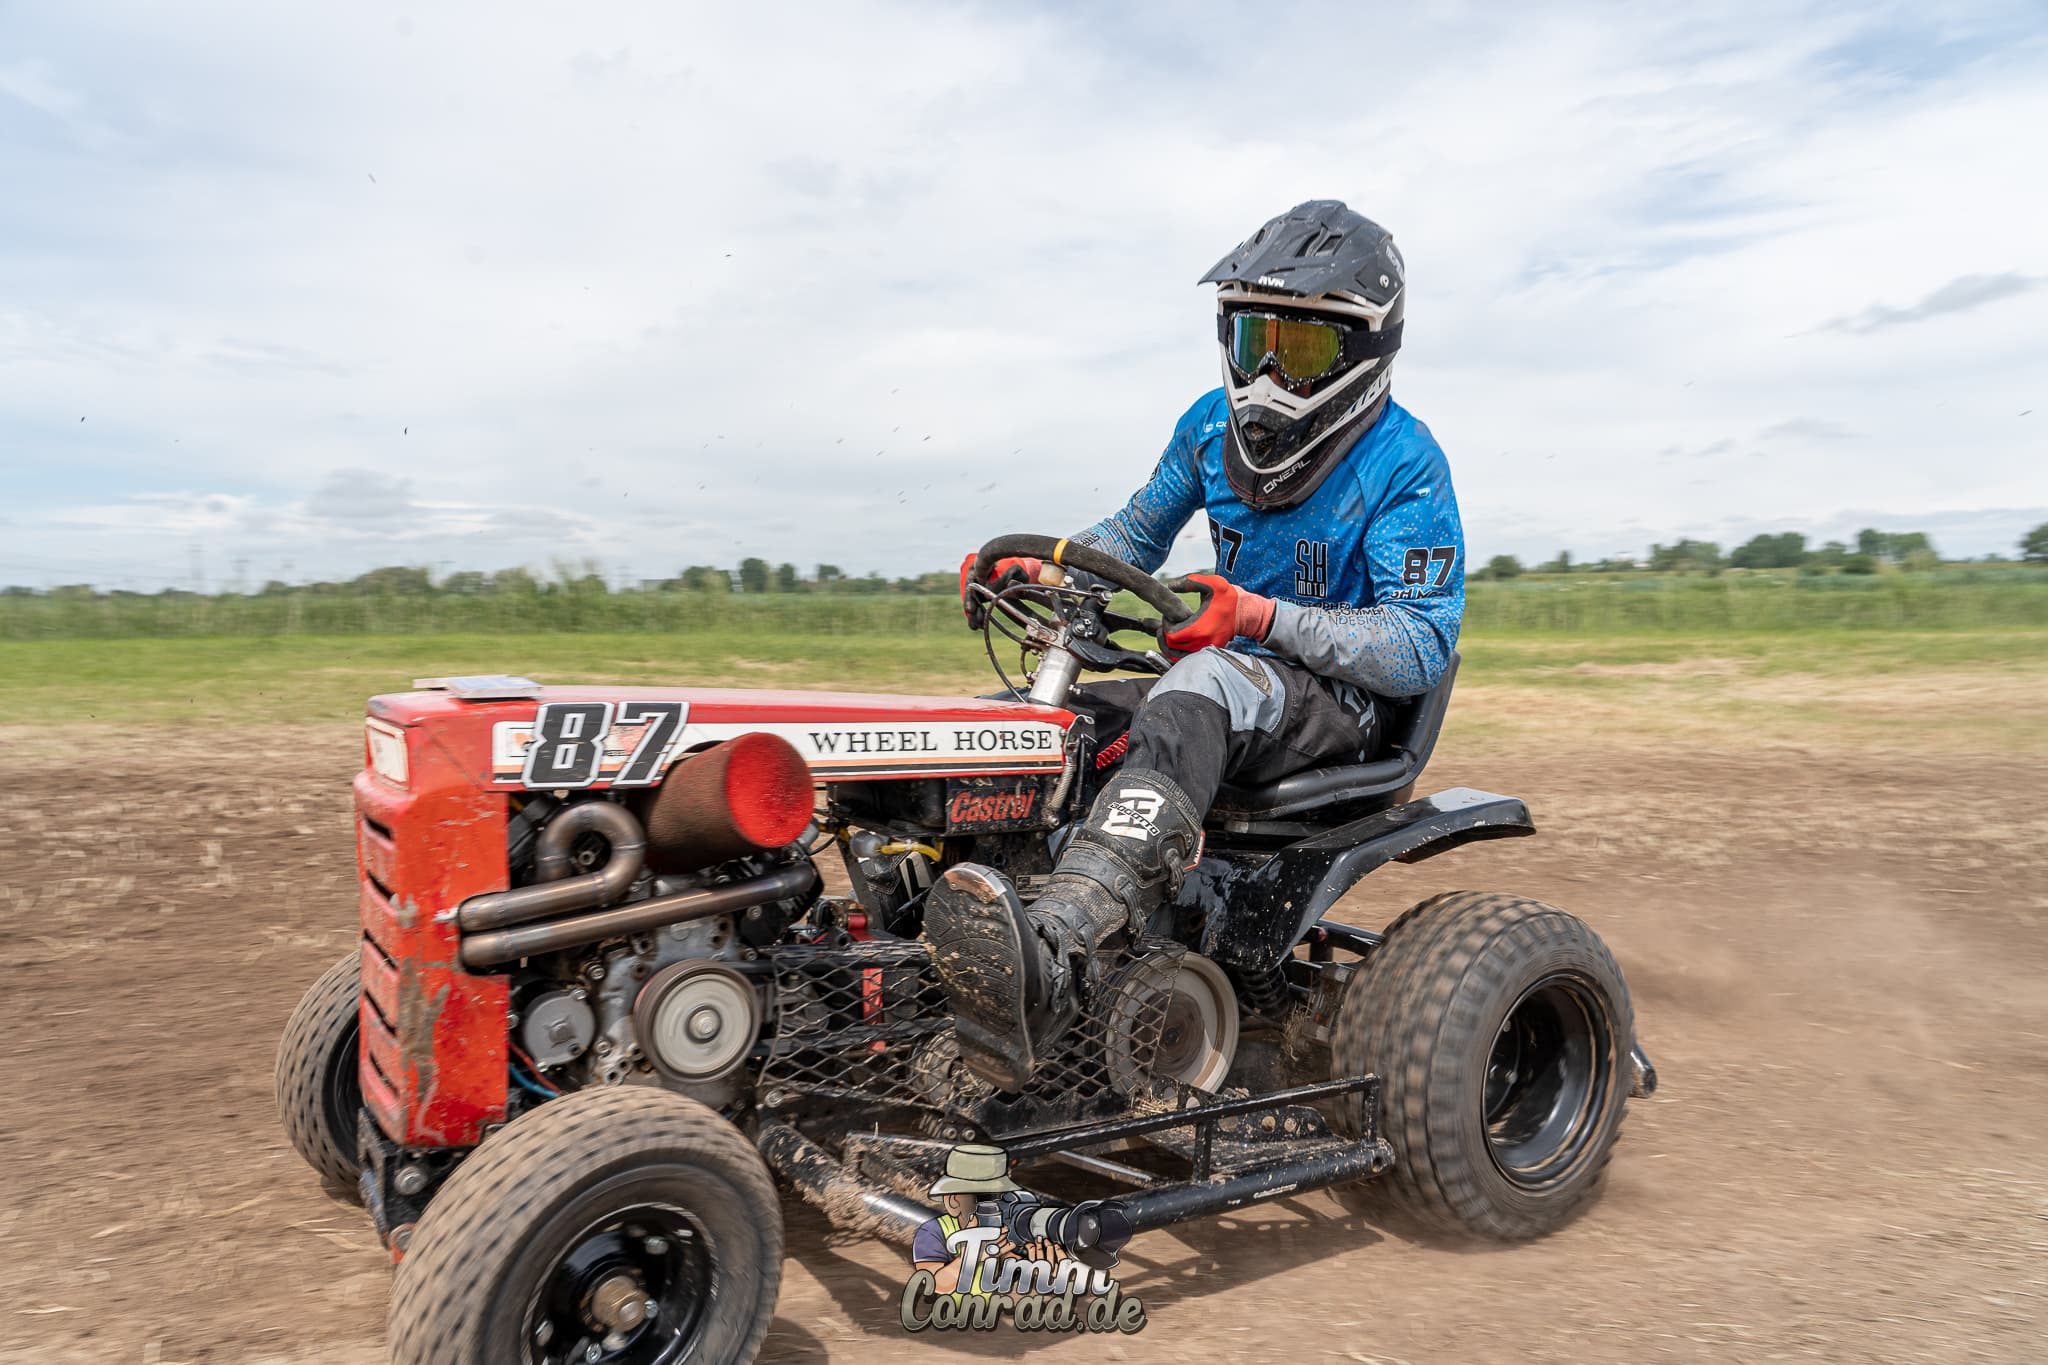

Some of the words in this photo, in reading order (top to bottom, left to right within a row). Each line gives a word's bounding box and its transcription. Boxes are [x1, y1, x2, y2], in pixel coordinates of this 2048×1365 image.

[1295, 538, 1328, 583] SH
[1403, 545, 1456, 588] 87
[1297, 580, 1327, 597] MOTO
[521, 701, 690, 790] 87
[809, 731, 937, 753] WHEEL
[953, 729, 1053, 751] HORSE
[951, 789, 1036, 824] Castrol
